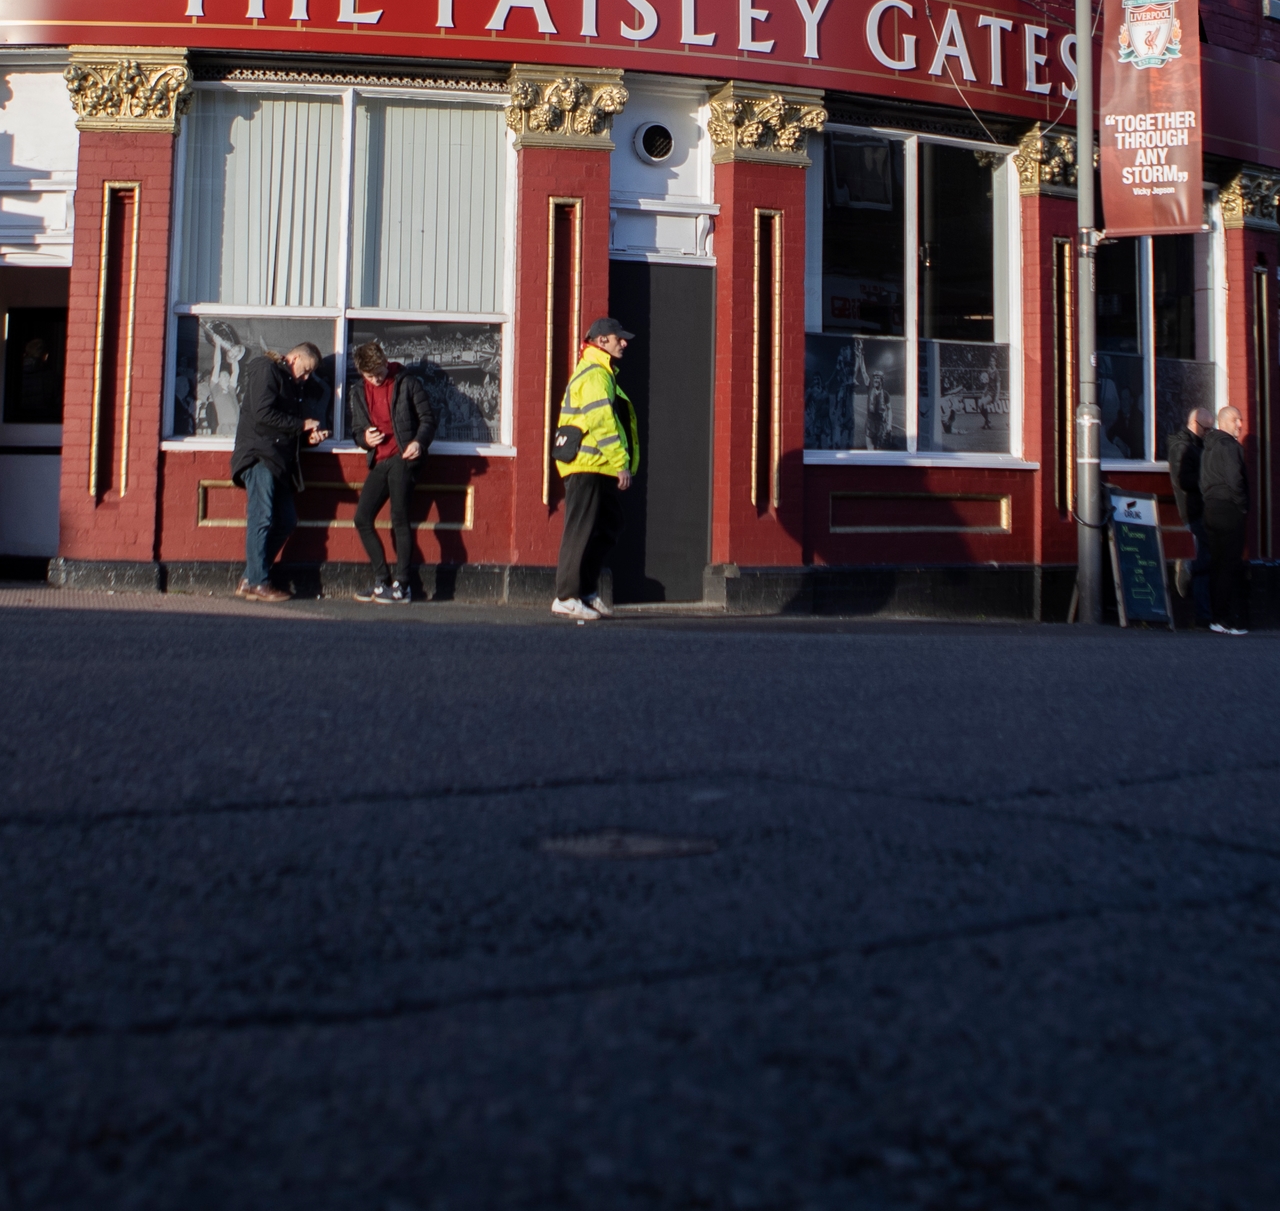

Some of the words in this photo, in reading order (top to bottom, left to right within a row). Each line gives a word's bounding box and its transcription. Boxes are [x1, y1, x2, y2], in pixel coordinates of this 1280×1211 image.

[1130, 10, 1171, 22] LIVERPOOL
[1114, 129, 1189, 149] THROUGH
[1135, 148, 1168, 166] ANY
[1133, 187, 1151, 196] Vicky
[1152, 187, 1175, 195] Jepson
